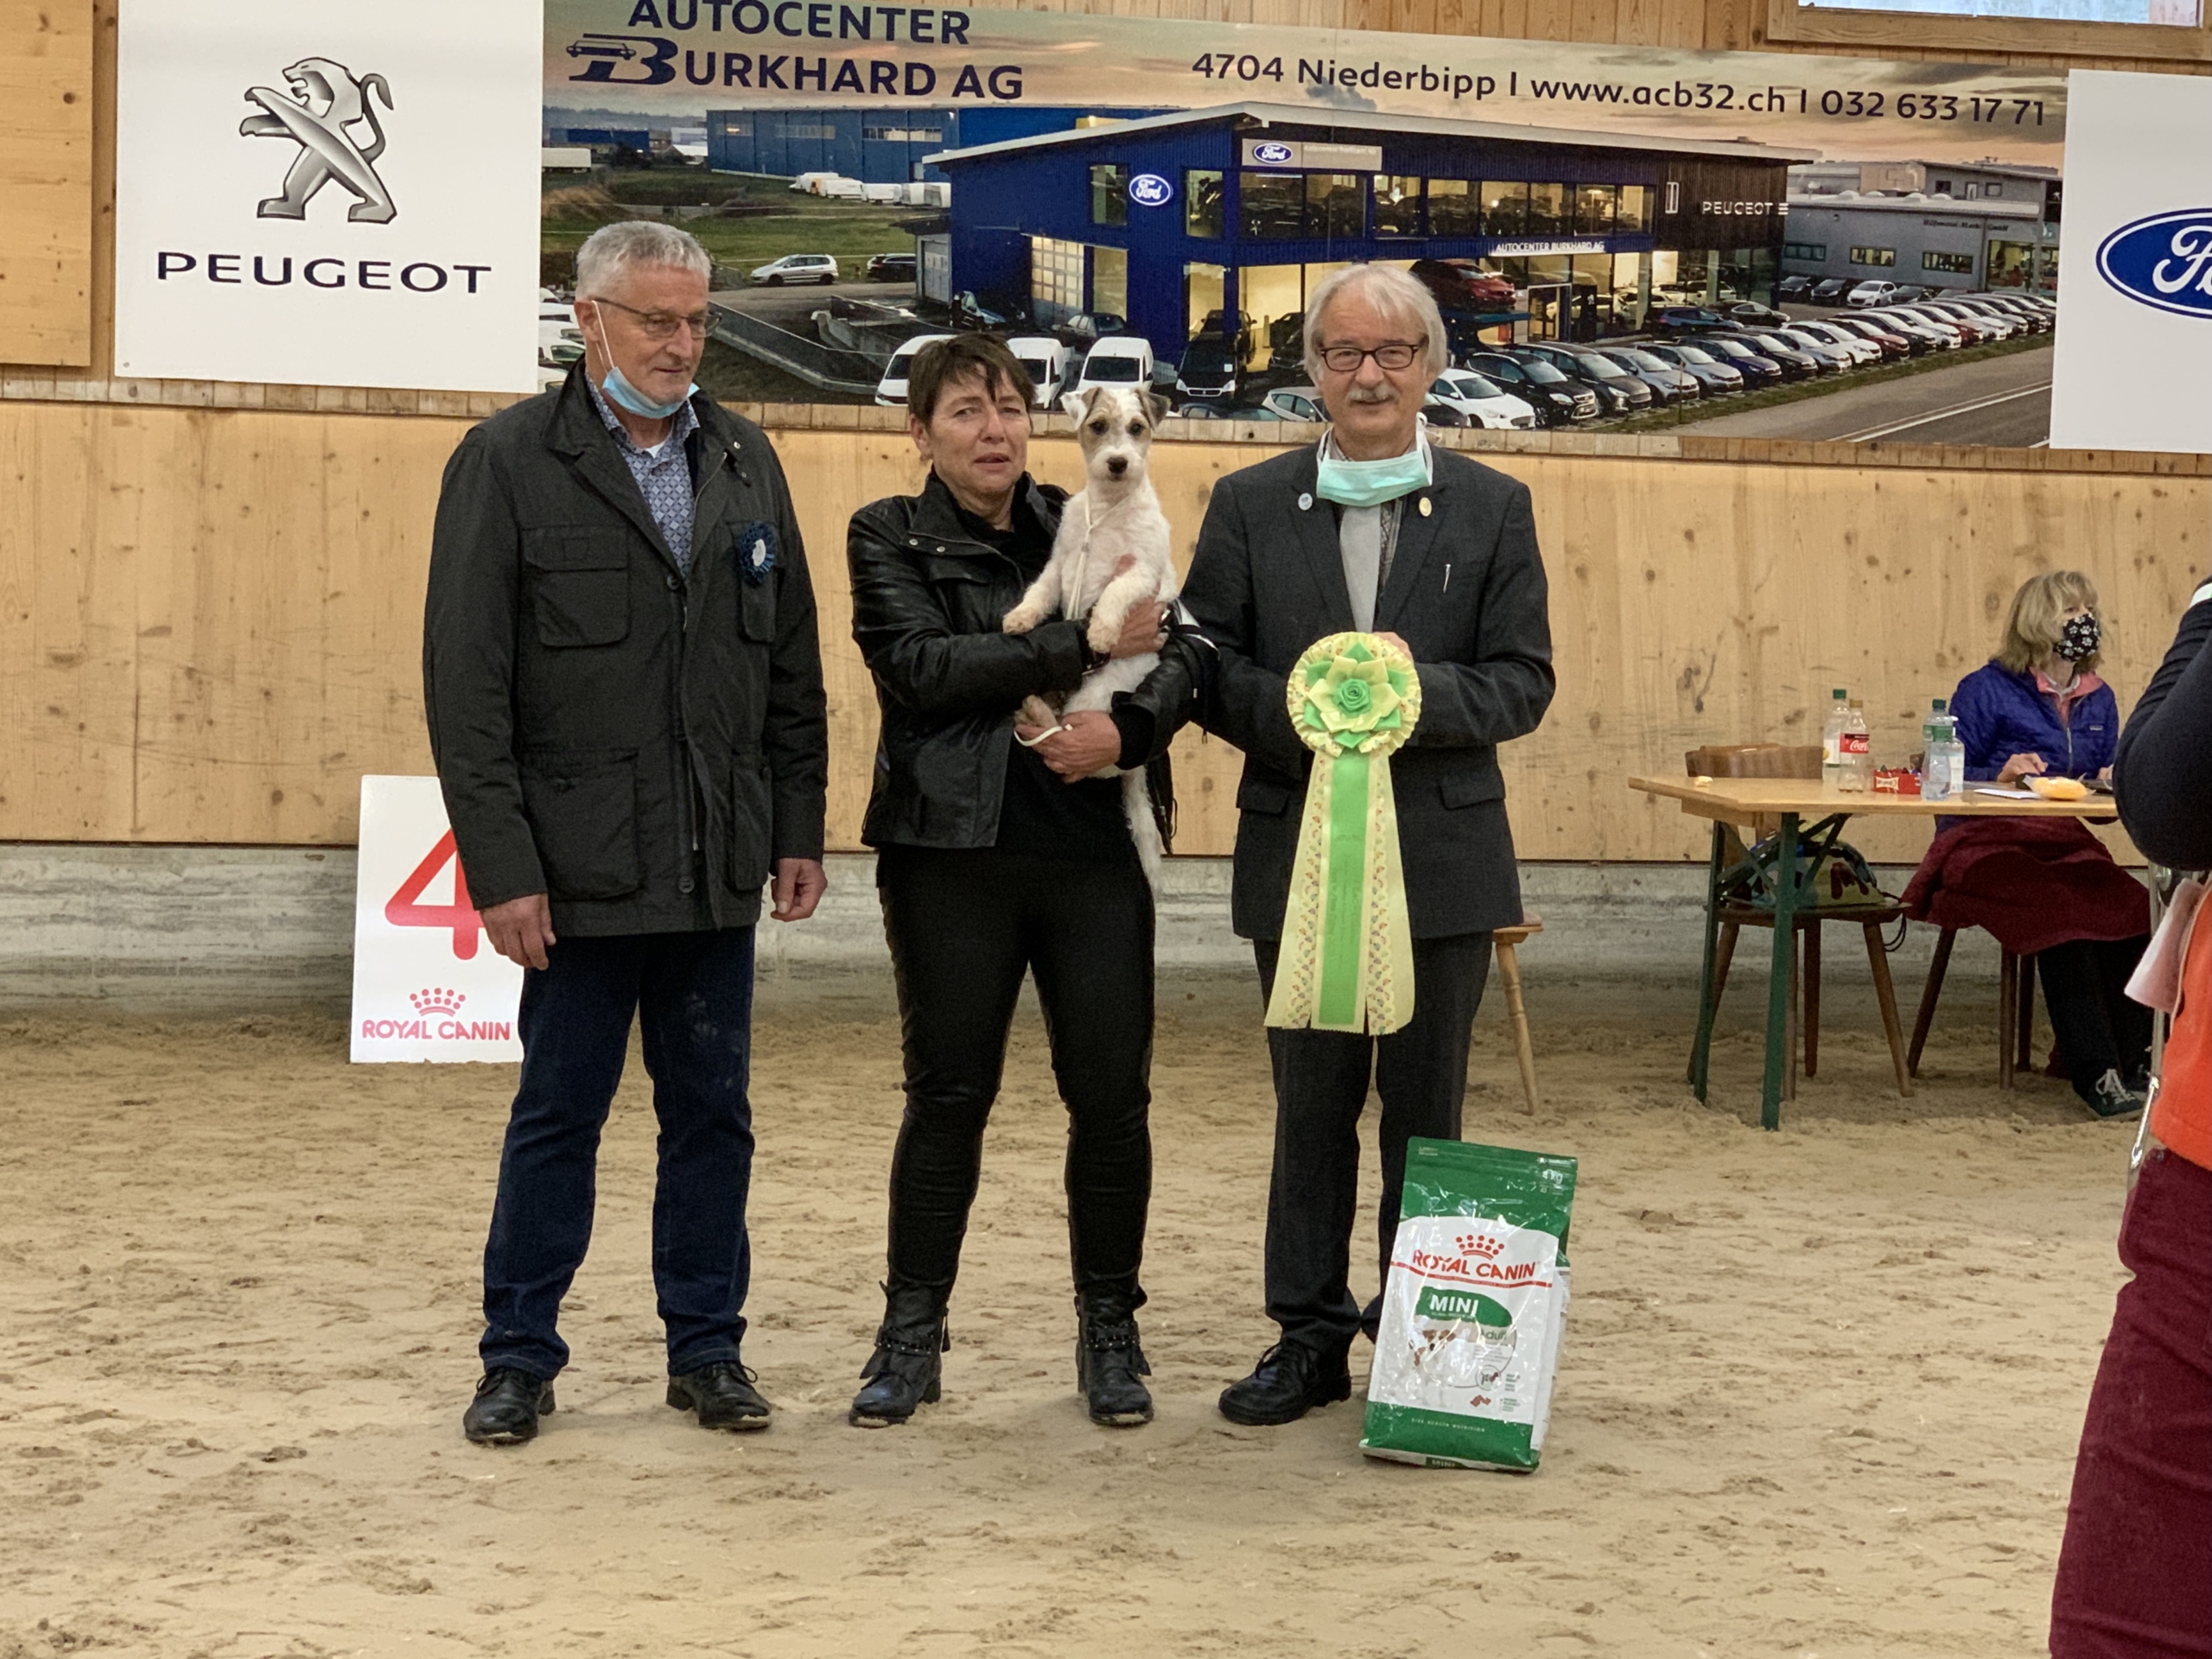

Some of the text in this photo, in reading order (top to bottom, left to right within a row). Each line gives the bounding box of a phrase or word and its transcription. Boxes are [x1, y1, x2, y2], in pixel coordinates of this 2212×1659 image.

[628, 0, 969, 44] AUTOCENTER
[569, 33, 1022, 100] BURKHARD AG
[1192, 53, 1284, 82] 4704
[1298, 58, 1497, 101] Niederbipp
[1530, 80, 1786, 112] www.acb32.ch
[1821, 90, 1885, 117] 032
[1897, 93, 1958, 120] 633
[1970, 97, 2002, 123] 17
[2012, 99, 2044, 125] 71
[1496, 242, 1549, 252] AUTOCENTER
[1551, 241, 1592, 251] BURKHARD
[158, 251, 492, 294] PEUGEOT
[385, 827, 485, 961] 4
[362, 1020, 510, 1041] ROYAL CANIN
[1413, 1249, 1471, 1275] ROYAL
[1476, 1262, 1536, 1281] CANIN
[1429, 1294, 1479, 1316] MINI
